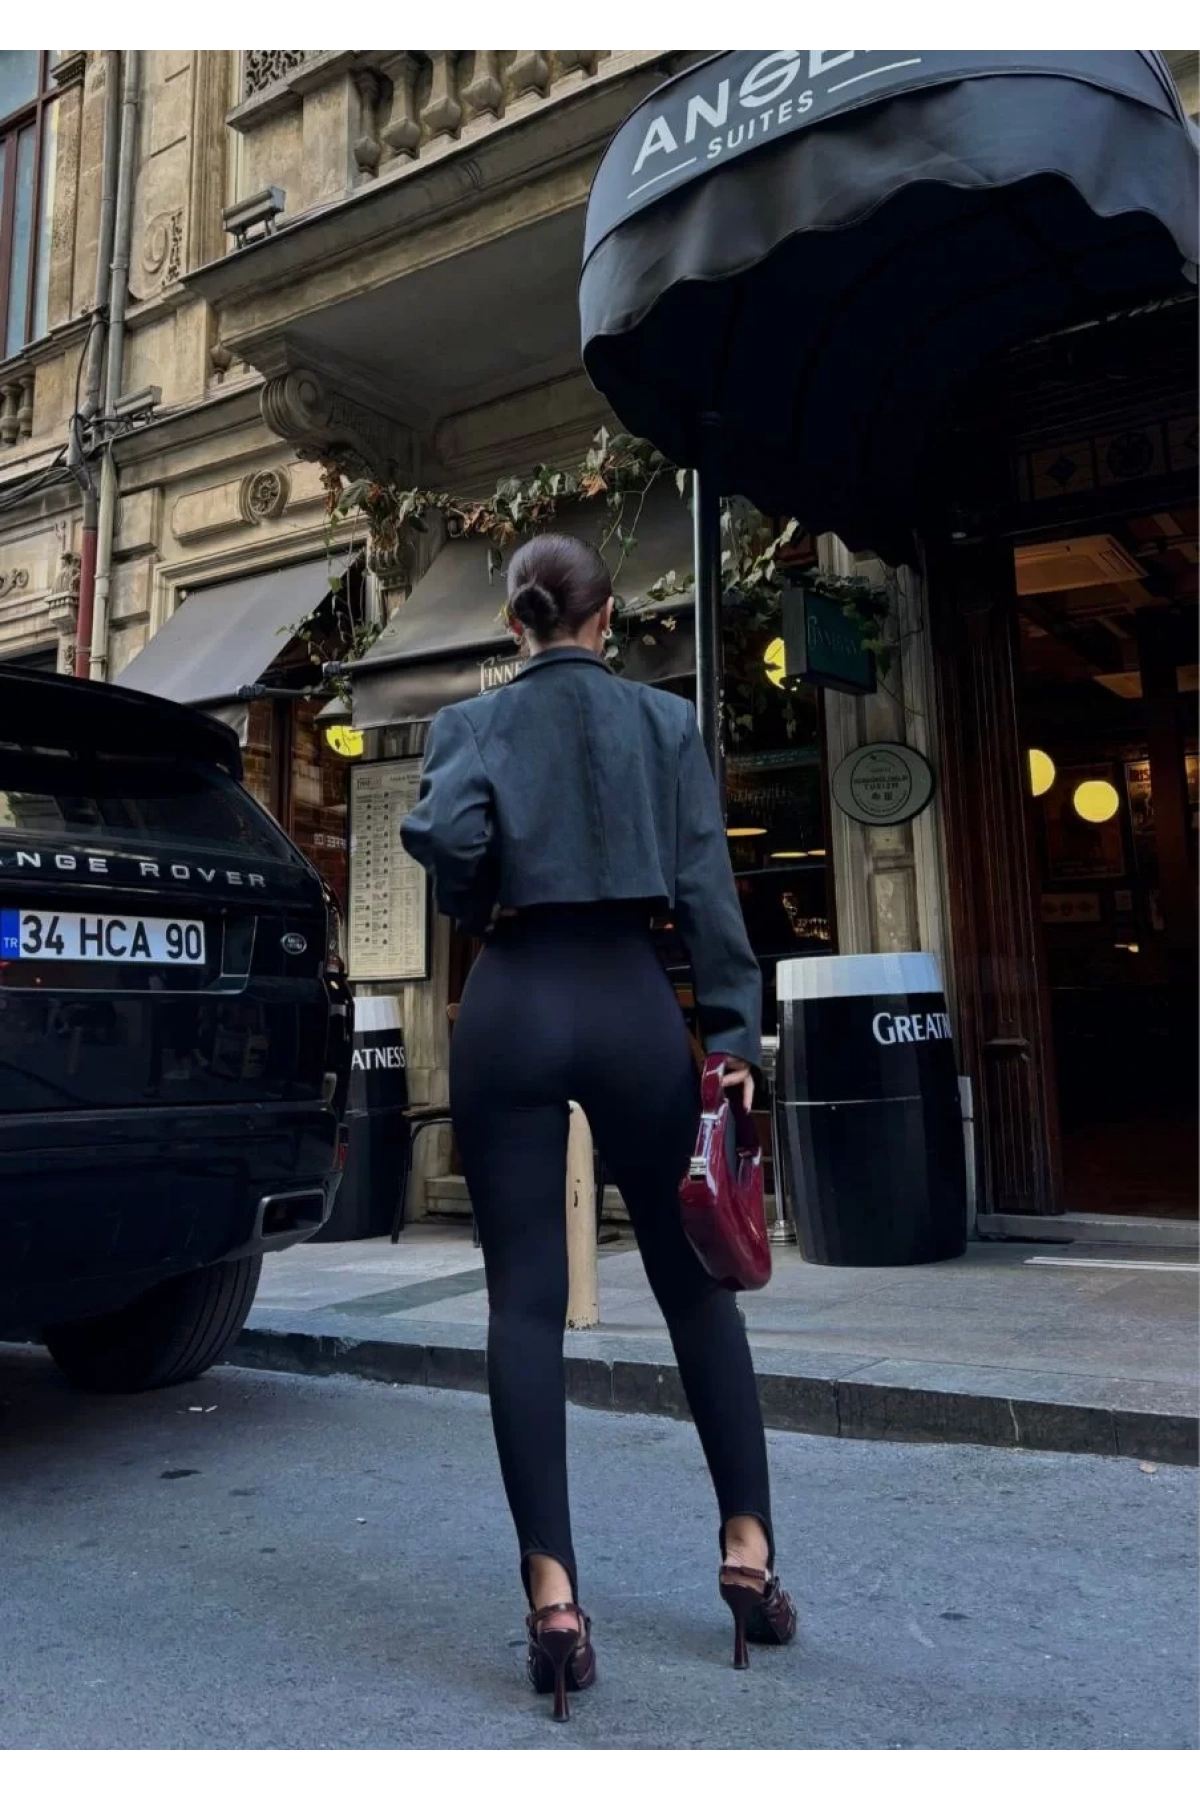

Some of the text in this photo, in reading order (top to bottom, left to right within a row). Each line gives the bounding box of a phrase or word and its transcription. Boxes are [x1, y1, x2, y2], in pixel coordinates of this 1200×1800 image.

[632, 48, 873, 175] ANGE
[706, 90, 814, 159] SUITES
[0, 851, 266, 888] NGE ROVER
[3, 915, 202, 960] TR 34 HCA 90
